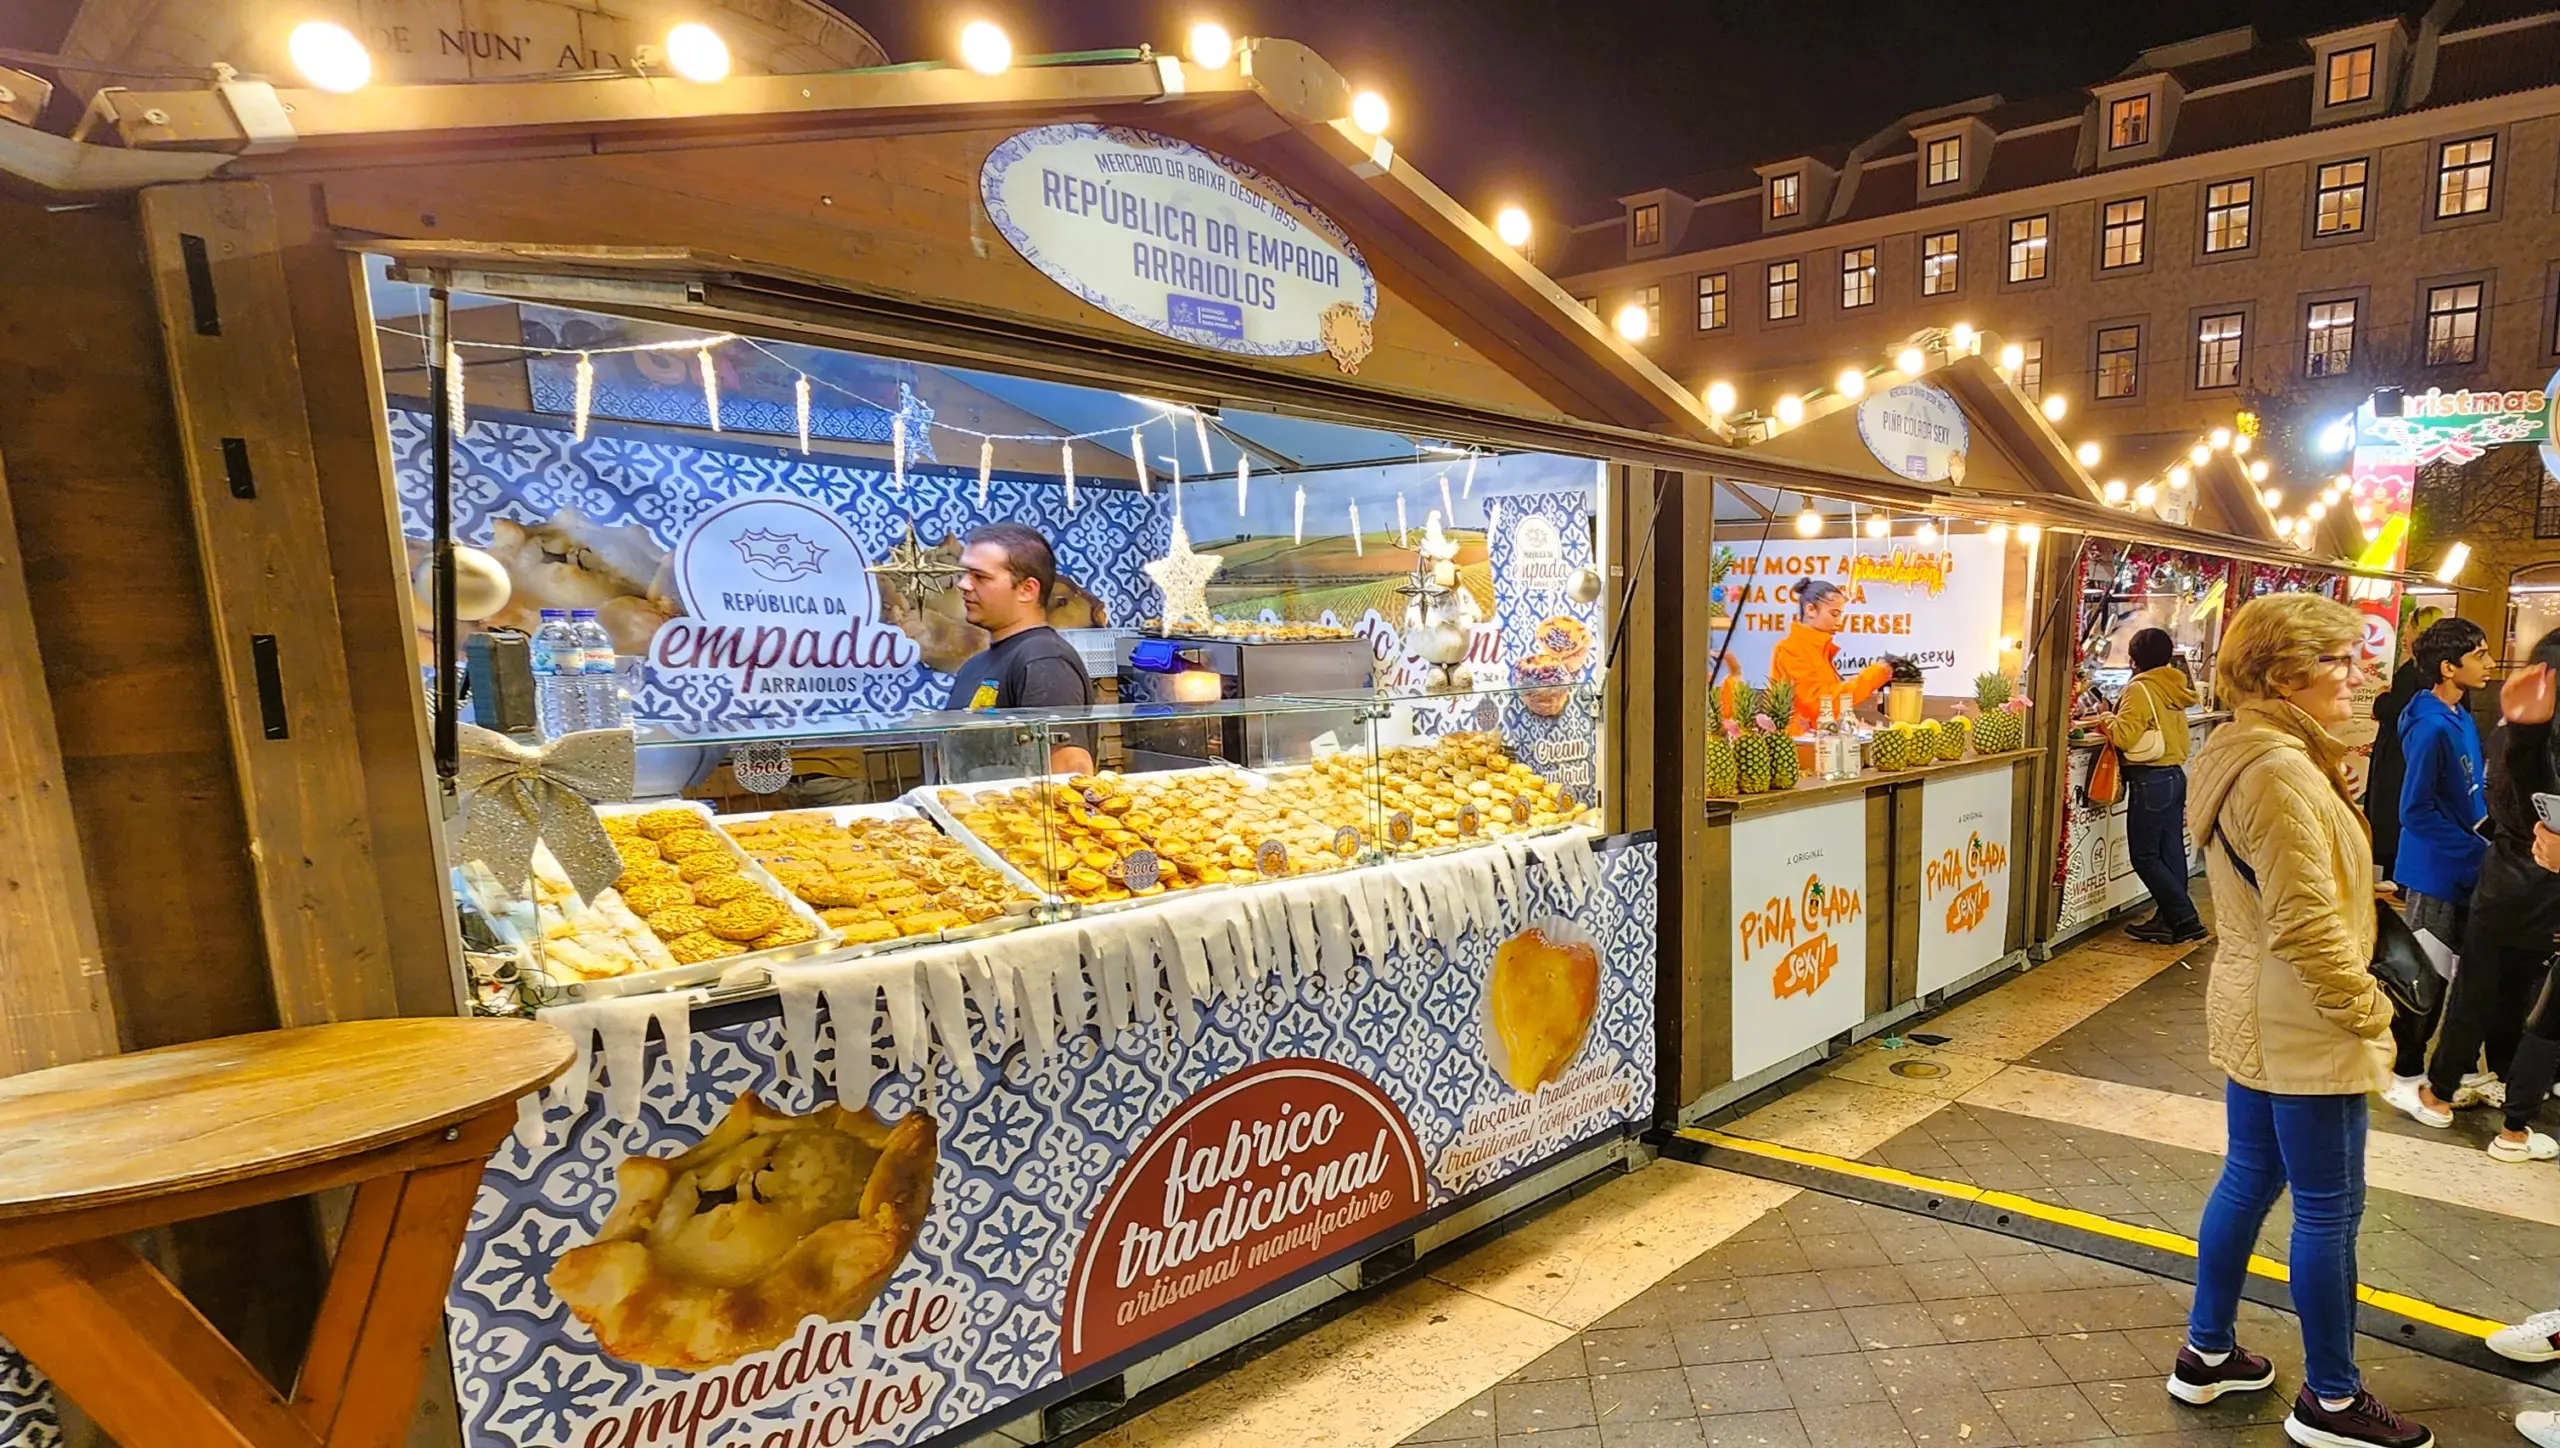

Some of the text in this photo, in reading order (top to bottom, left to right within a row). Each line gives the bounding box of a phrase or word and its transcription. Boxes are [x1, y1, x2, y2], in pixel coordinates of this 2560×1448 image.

[439, 29, 531, 62] NUN'
[1094, 153, 1300, 232] MERCADO DA BAIXA DESDE 1855
[1042, 168, 1339, 288] REPÚBLICA DA EMPADA
[1133, 242, 1276, 310] ARRAIOLOS
[2402, 387, 2547, 418] ristmas
[1883, 409, 1951, 445] PIÑA COLADA SEXY
[1731, 558, 1758, 576] HE
[1764, 555, 1830, 576] MOST
[722, 589, 847, 616] REPÚBLICA DA
[1745, 613, 1786, 632] THE
[658, 615, 914, 694] empada
[1834, 649, 1955, 670] pinaasexy
[760, 676, 858, 694] ARRAIOLOS
[737, 759, 790, 778] 3,50€
[1537, 740, 1585, 763] Cream
[1786, 849, 1824, 866] A ORIGINAL
[1926, 848, 1963, 901] PIÑA
[2073, 872, 2106, 896] WAFFLES
[1740, 896, 1796, 962] PIÑA
[1469, 1056, 1612, 1136] doçaria tradicional
[1446, 1082, 1632, 1175] traditional confectionery
[1163, 1102, 1345, 1228] fabrico
[1116, 1128, 1390, 1289] tradicional
[1116, 1189, 1394, 1326] artisanal manufacture
[584, 1287, 958, 1448] empada de
